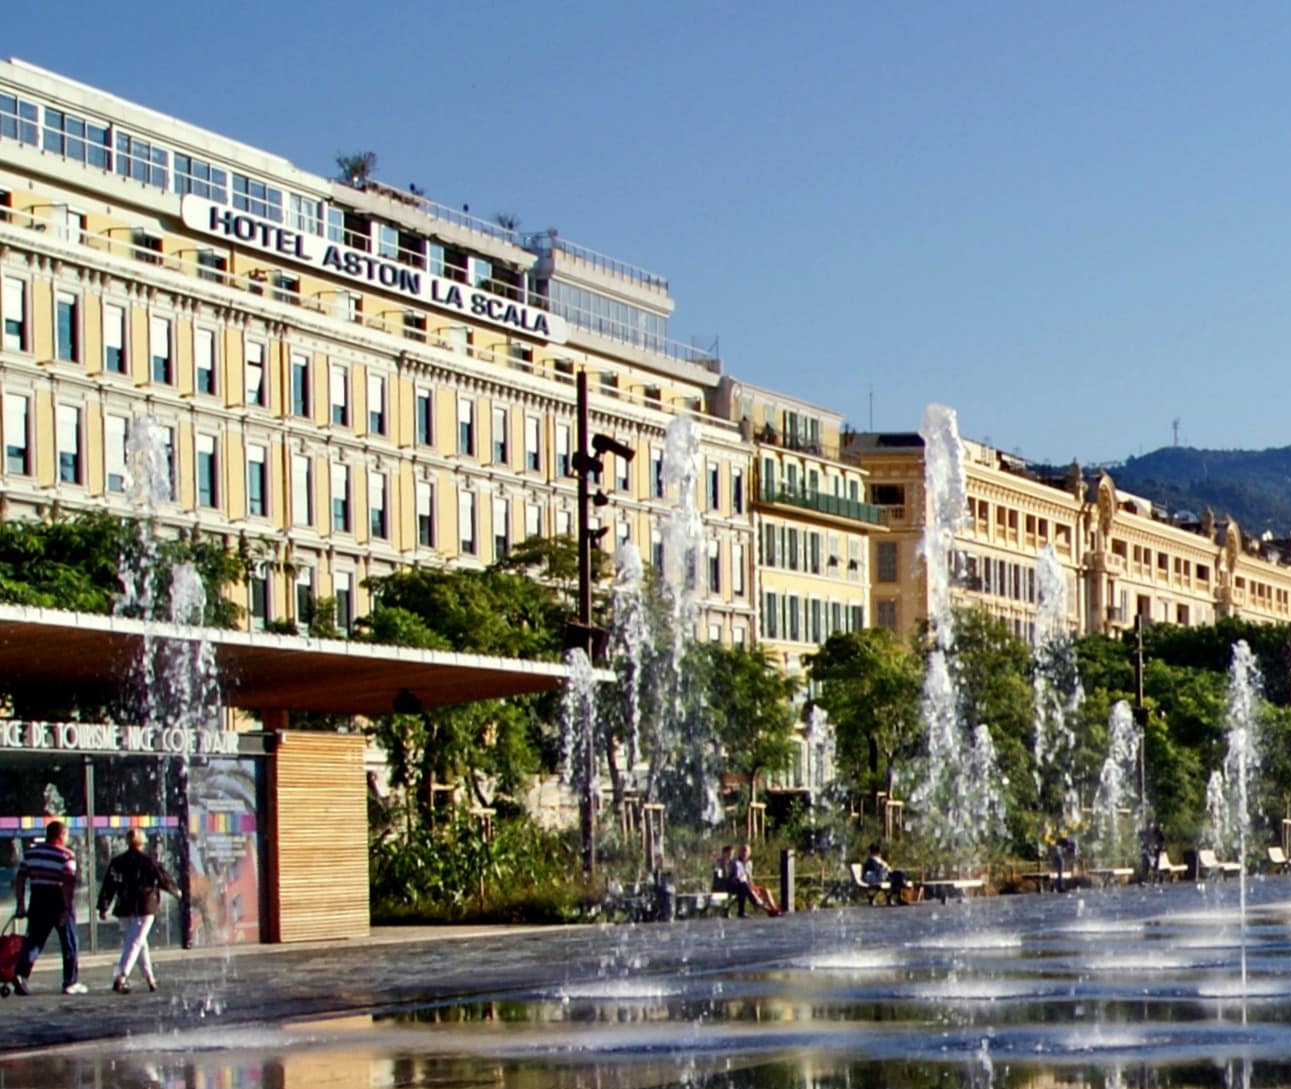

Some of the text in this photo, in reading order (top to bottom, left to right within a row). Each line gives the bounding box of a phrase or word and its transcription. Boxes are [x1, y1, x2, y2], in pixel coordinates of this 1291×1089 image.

[209, 206, 550, 336] HOTEL ASTON LA SCALA
[32, 720, 49, 748] DE
